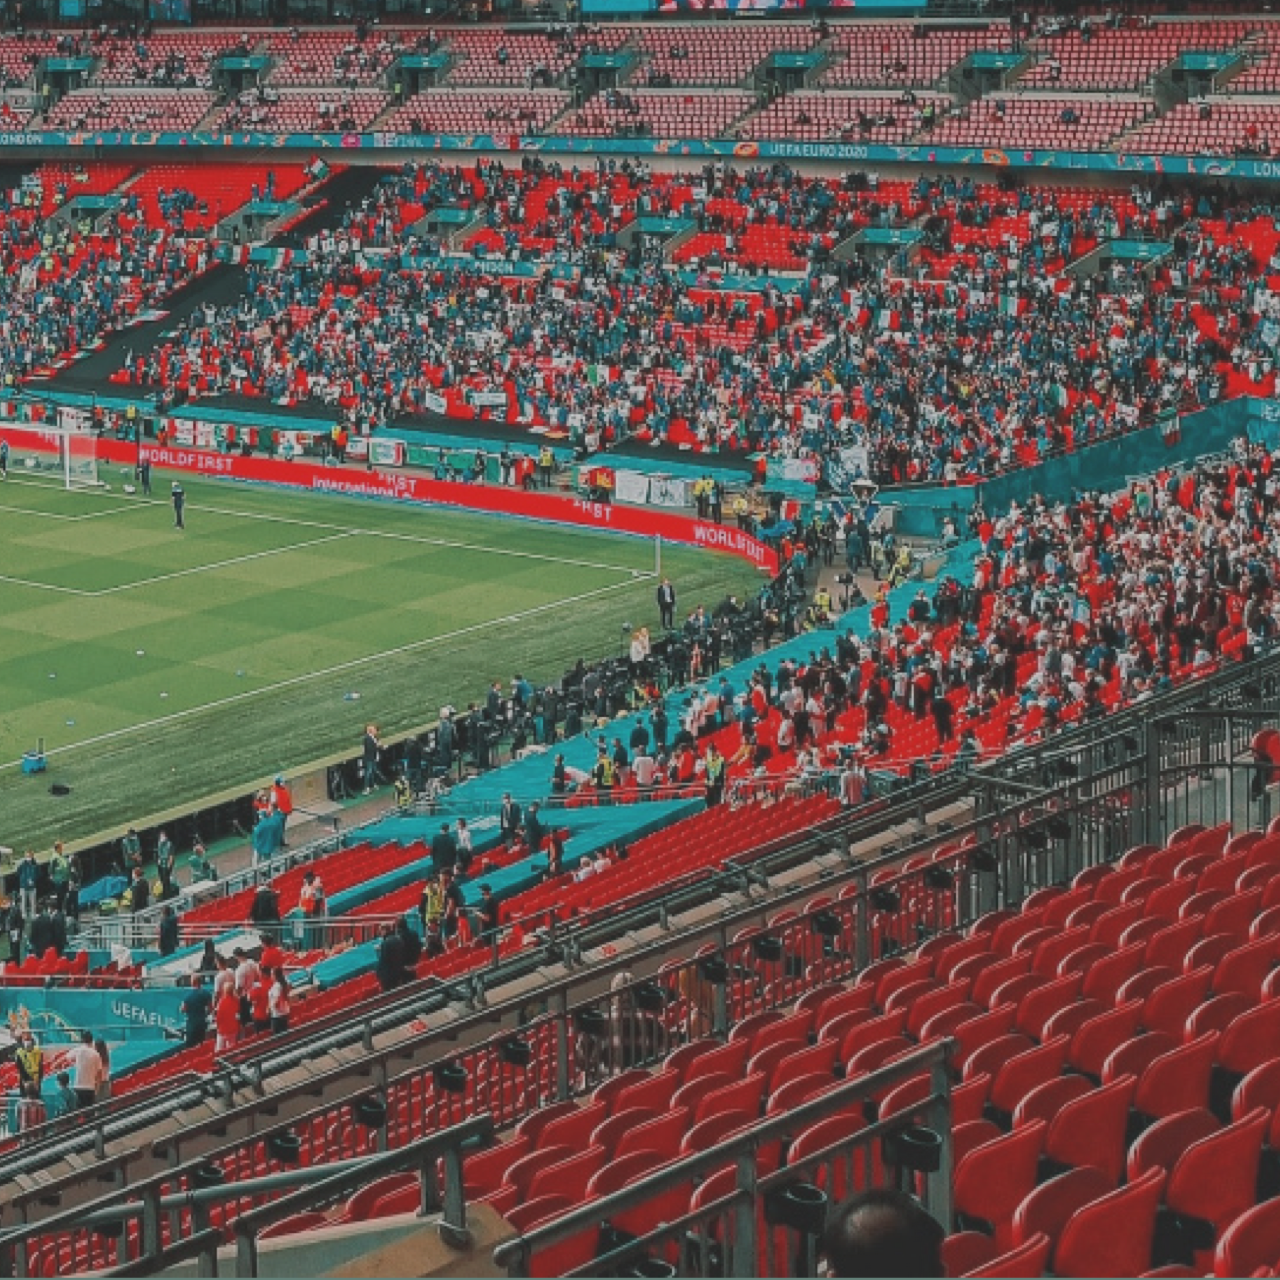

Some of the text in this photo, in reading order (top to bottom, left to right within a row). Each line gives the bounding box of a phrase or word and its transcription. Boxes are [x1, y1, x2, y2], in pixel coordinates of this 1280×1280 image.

[769, 142, 868, 160] UEFA EURO 2020
[139, 445, 234, 472] WORLDFIRST
[312, 474, 399, 498] International
[111, 999, 148, 1025] UEFA
